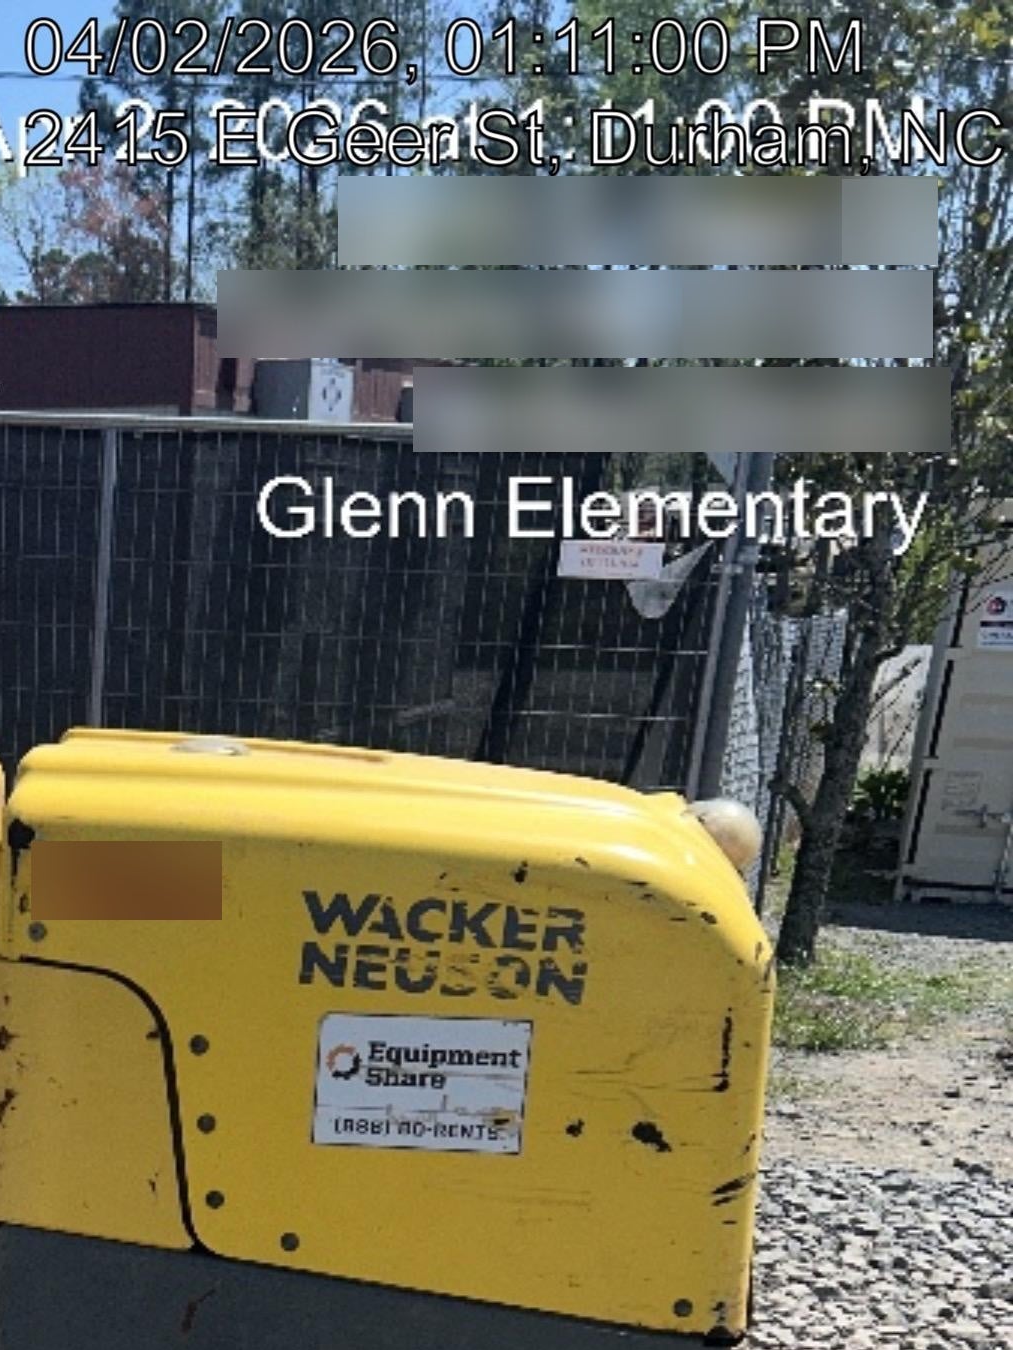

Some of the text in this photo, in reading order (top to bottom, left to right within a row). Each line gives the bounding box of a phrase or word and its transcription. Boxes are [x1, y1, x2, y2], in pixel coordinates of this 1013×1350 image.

[301, 889, 586, 953] WACKER
[367, 1040, 522, 1068] Equipment
[365, 1067, 447, 1089] Share
